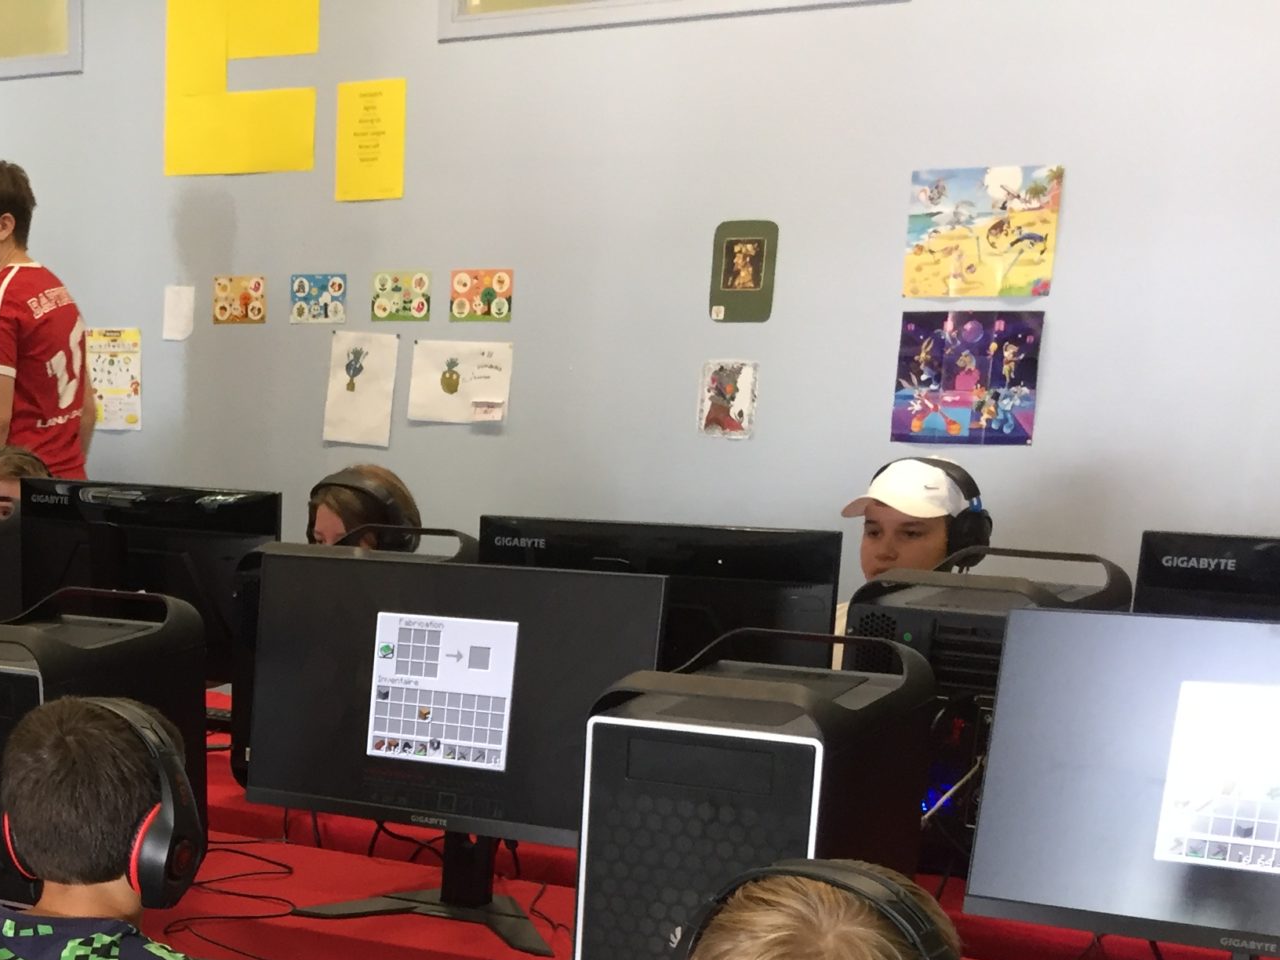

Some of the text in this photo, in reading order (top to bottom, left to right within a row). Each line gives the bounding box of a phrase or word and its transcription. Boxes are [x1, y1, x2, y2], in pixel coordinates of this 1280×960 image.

[494, 536, 546, 549] GIGABYTE
[1161, 555, 1237, 571] GIGABYTE
[398, 617, 445, 629] Fabrication
[377, 675, 419, 686] Inventaire
[1220, 937, 1277, 953] GIGABYTE
